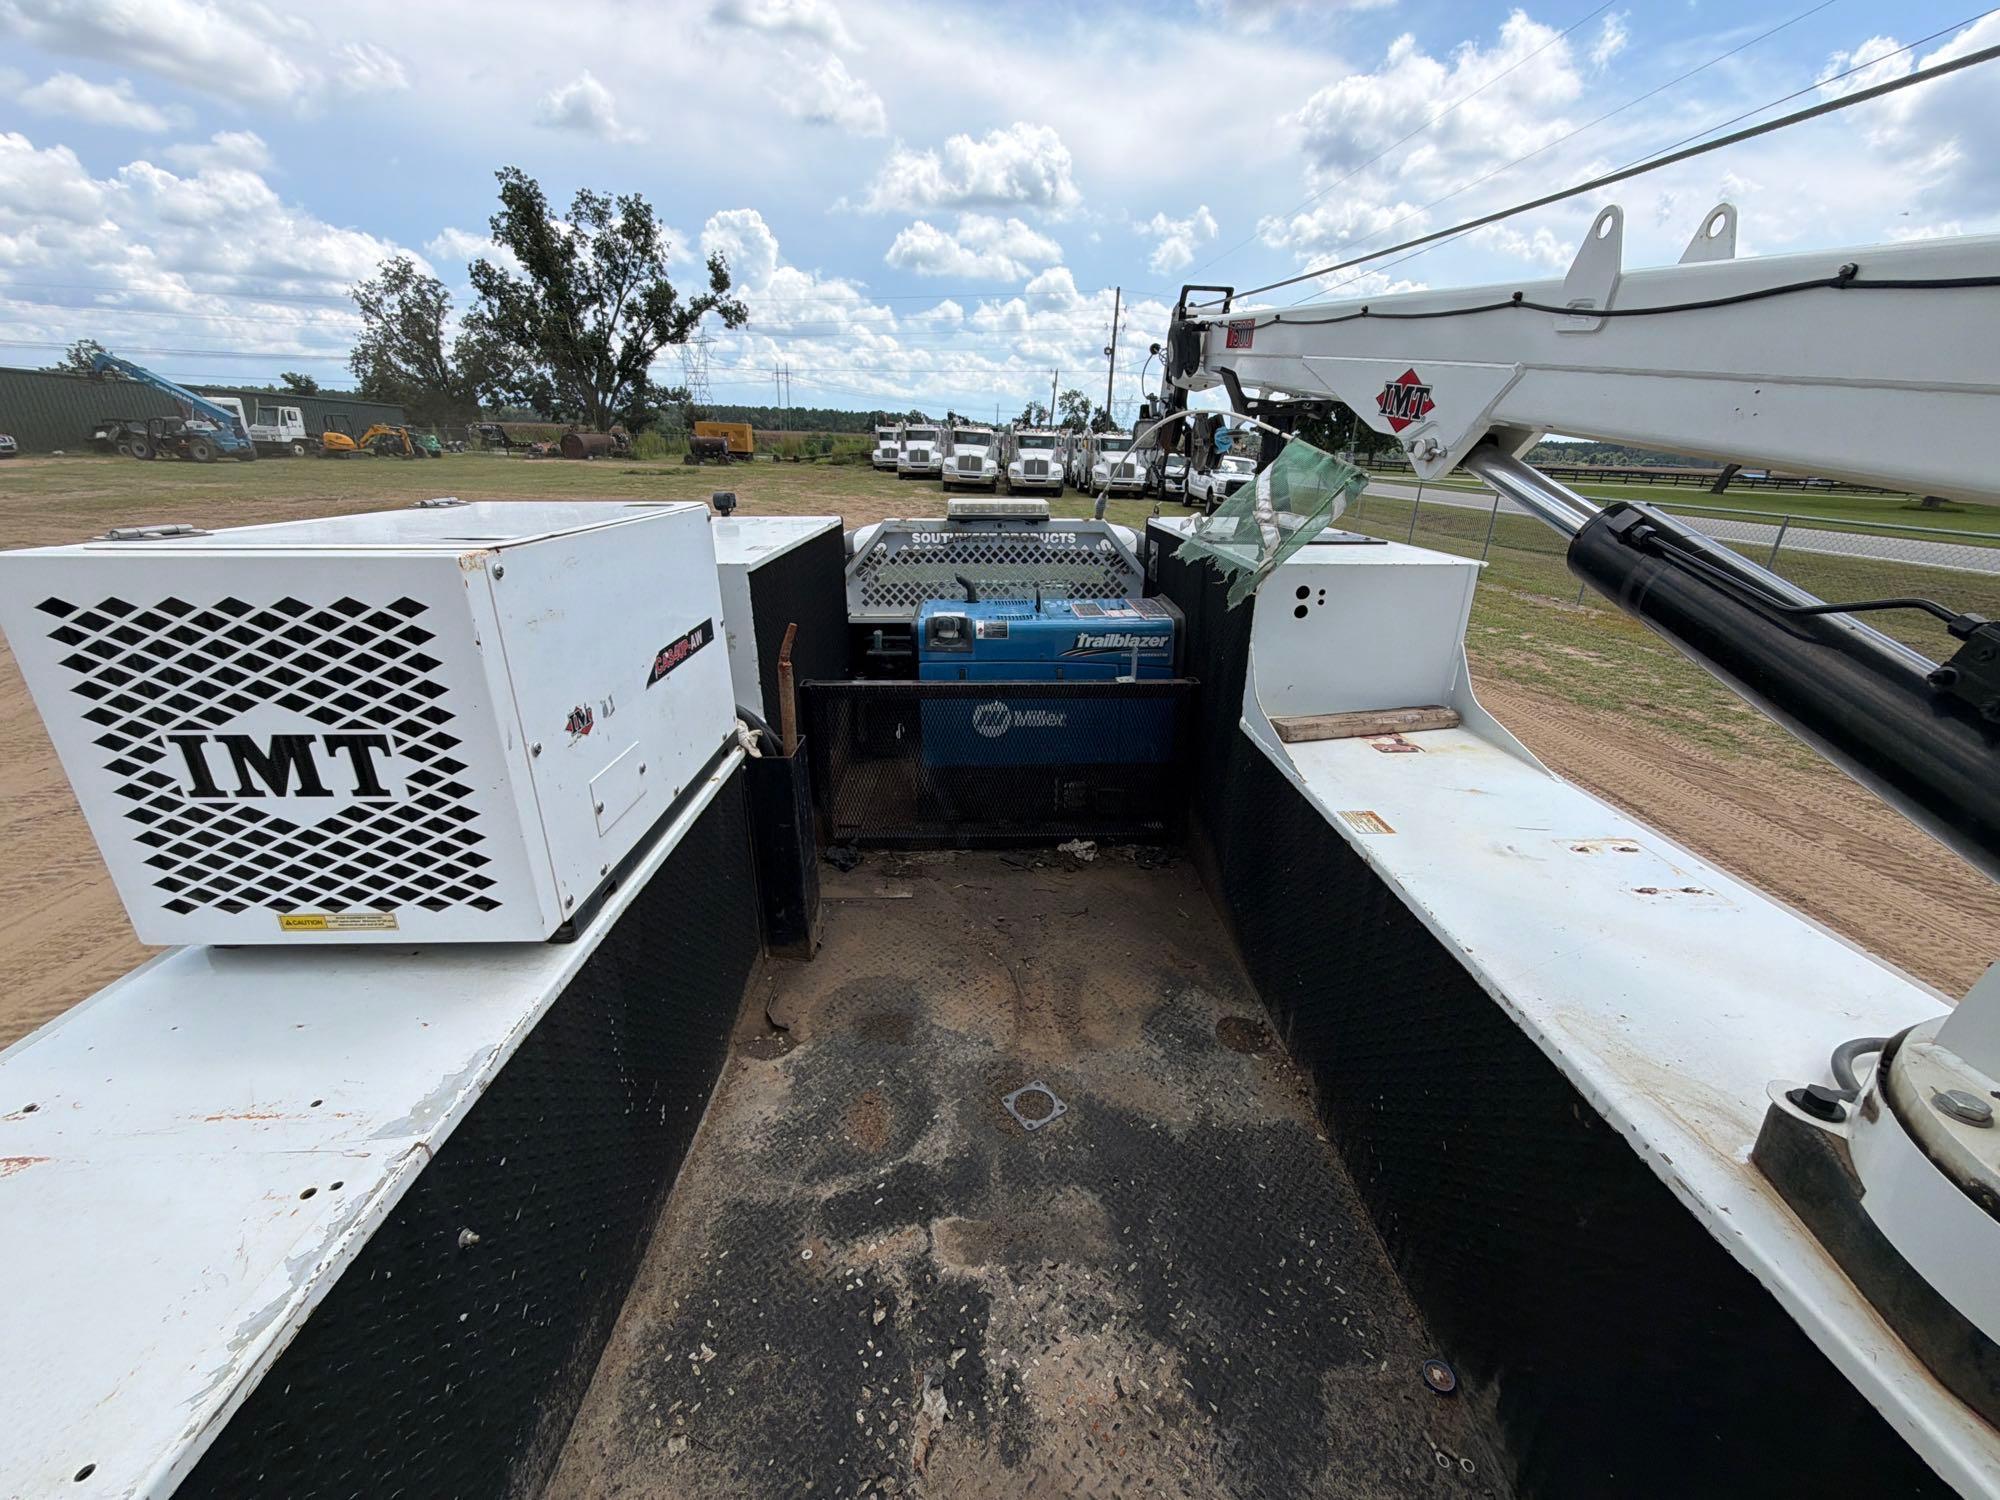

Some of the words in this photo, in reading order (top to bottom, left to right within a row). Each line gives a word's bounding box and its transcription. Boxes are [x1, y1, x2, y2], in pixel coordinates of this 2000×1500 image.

[1379, 383, 1432, 420] IMT
[1077, 632, 1170, 648] Trailblazer
[569, 703, 592, 736] IM
[166, 734, 392, 798] IMT
[293, 919, 323, 927] CAUTION
